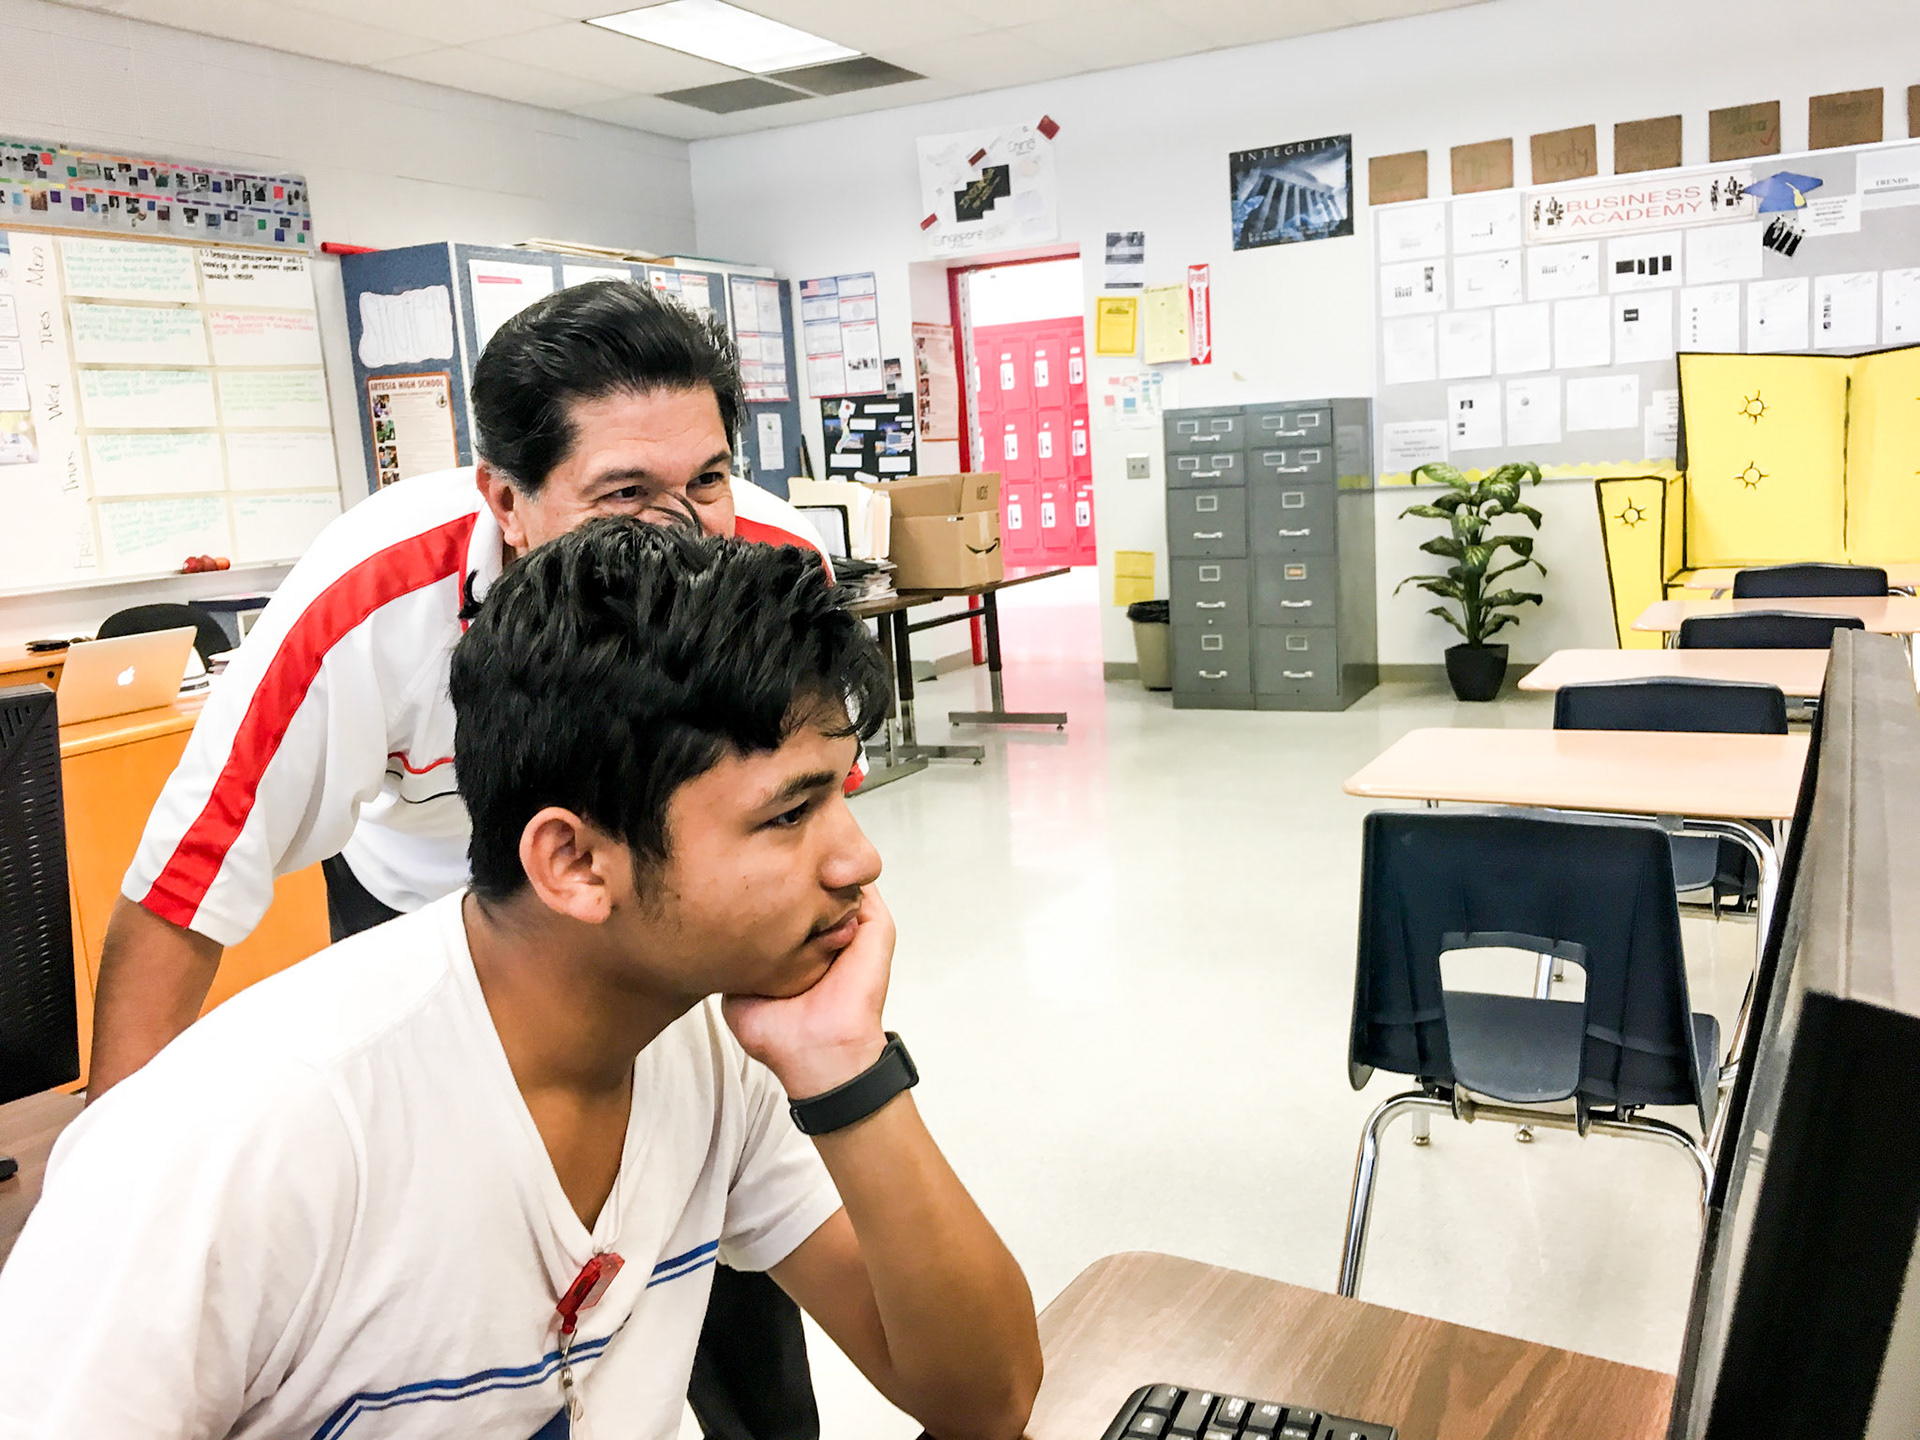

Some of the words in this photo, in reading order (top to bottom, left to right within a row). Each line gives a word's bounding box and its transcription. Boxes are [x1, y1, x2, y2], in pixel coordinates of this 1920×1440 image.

[1238, 138, 1341, 163] INTEGRITY
[1875, 177, 1909, 187] TRENDS
[1567, 186, 1701, 213] BUSINESS
[1570, 201, 1703, 227] ACADEMY
[26, 246, 45, 287] Mon
[371, 381, 397, 392] ARTESIA
[398, 380, 416, 390] HIGH
[418, 378, 445, 389] SCHOOL
[44, 382, 63, 421] Wed
